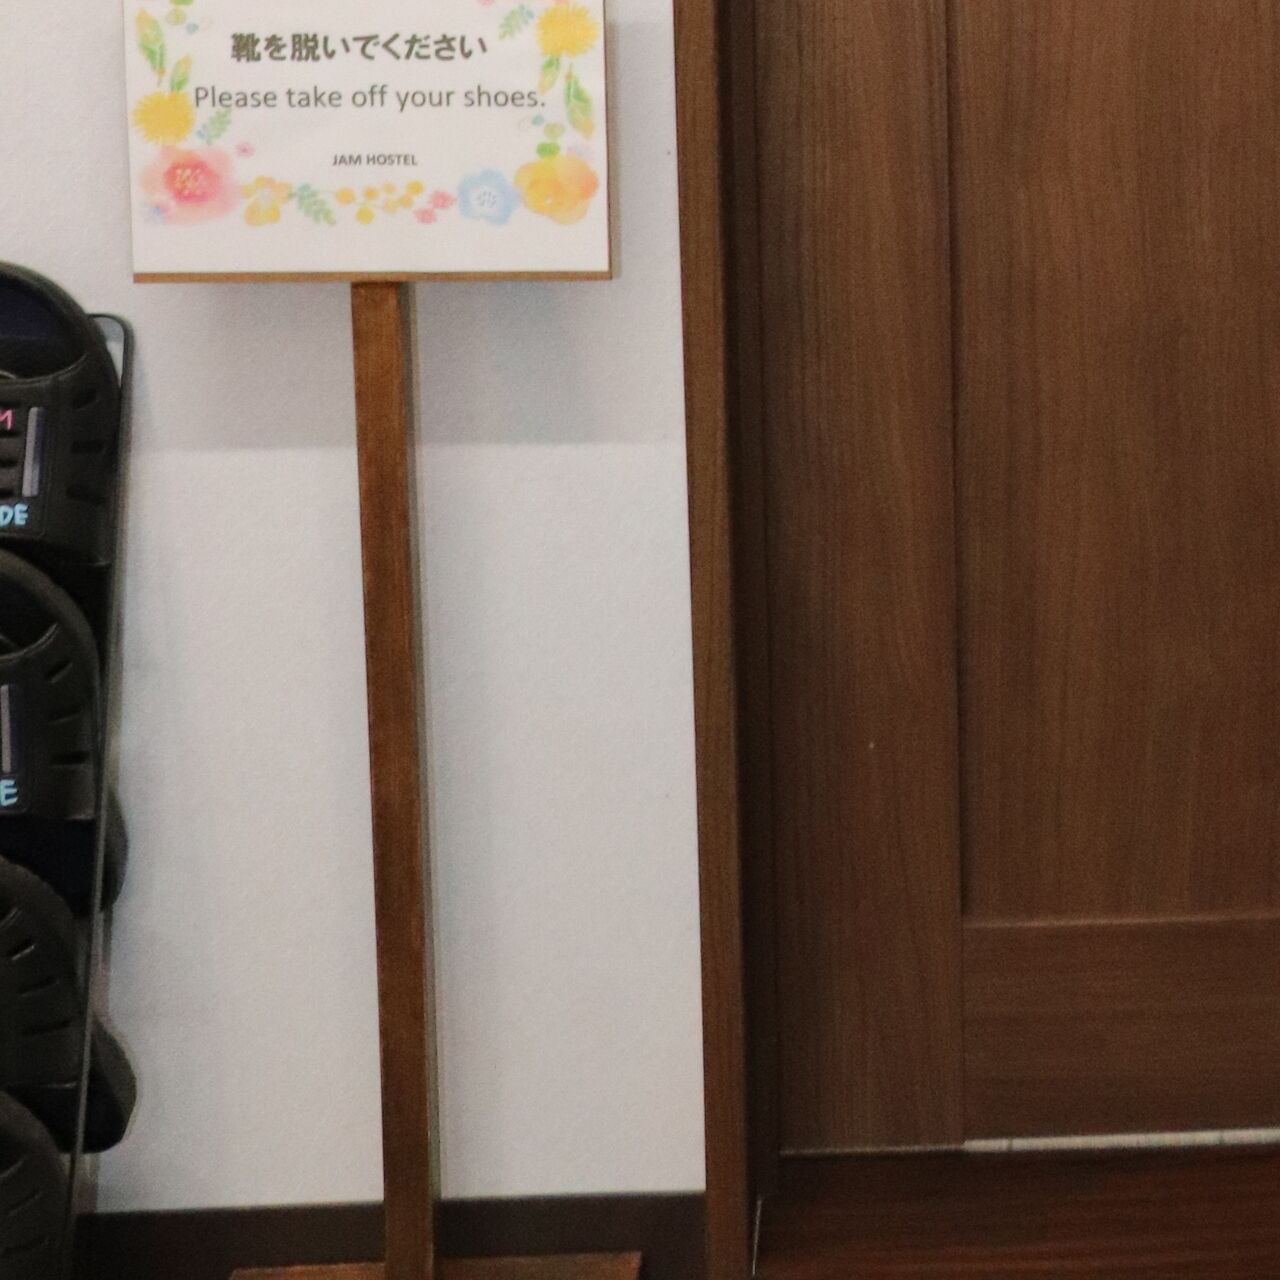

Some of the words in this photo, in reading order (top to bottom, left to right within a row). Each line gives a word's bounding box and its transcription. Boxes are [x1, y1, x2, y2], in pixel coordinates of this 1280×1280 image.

[230, 32, 488, 62] 靴を脱いでください
[195, 86, 277, 108] Please
[286, 86, 342, 108] take
[351, 85, 388, 107] off
[396, 91, 455, 113] your
[464, 85, 545, 107] shoes.
[332, 154, 362, 166] JAM
[366, 154, 418, 166] HOSTEL
